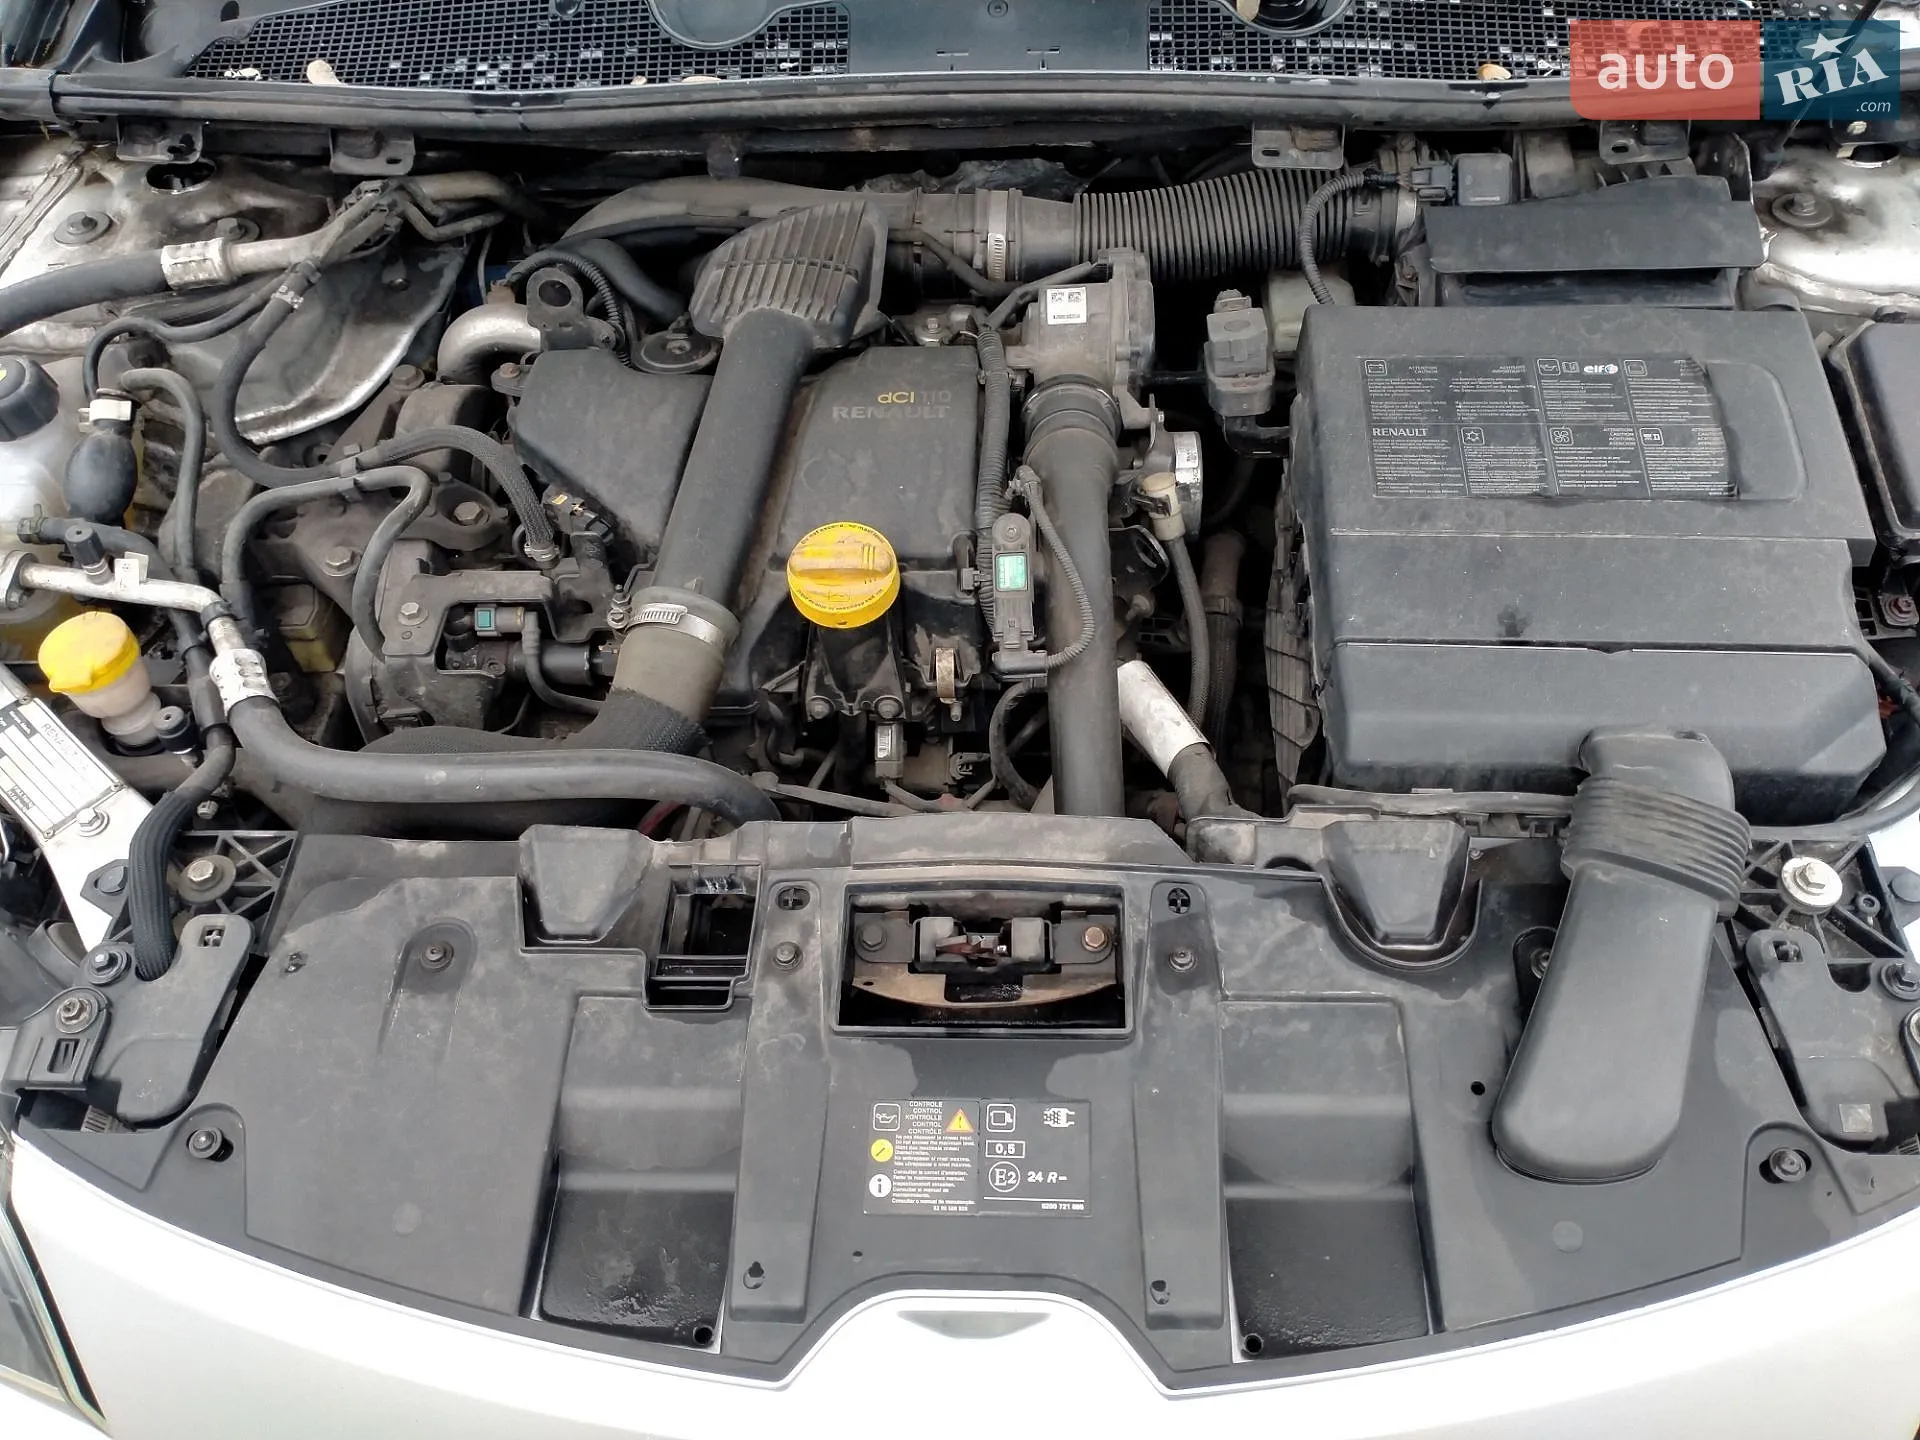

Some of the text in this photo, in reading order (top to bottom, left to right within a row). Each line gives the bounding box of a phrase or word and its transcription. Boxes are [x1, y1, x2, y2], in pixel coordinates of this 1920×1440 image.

[832, 405, 951, 420] RENAULT
[1372, 427, 1428, 437] RENAULT
[995, 1143, 1016, 1156] 0,5
[994, 1167, 1017, 1187] E2
[1027, 1170, 1044, 1183] 24
